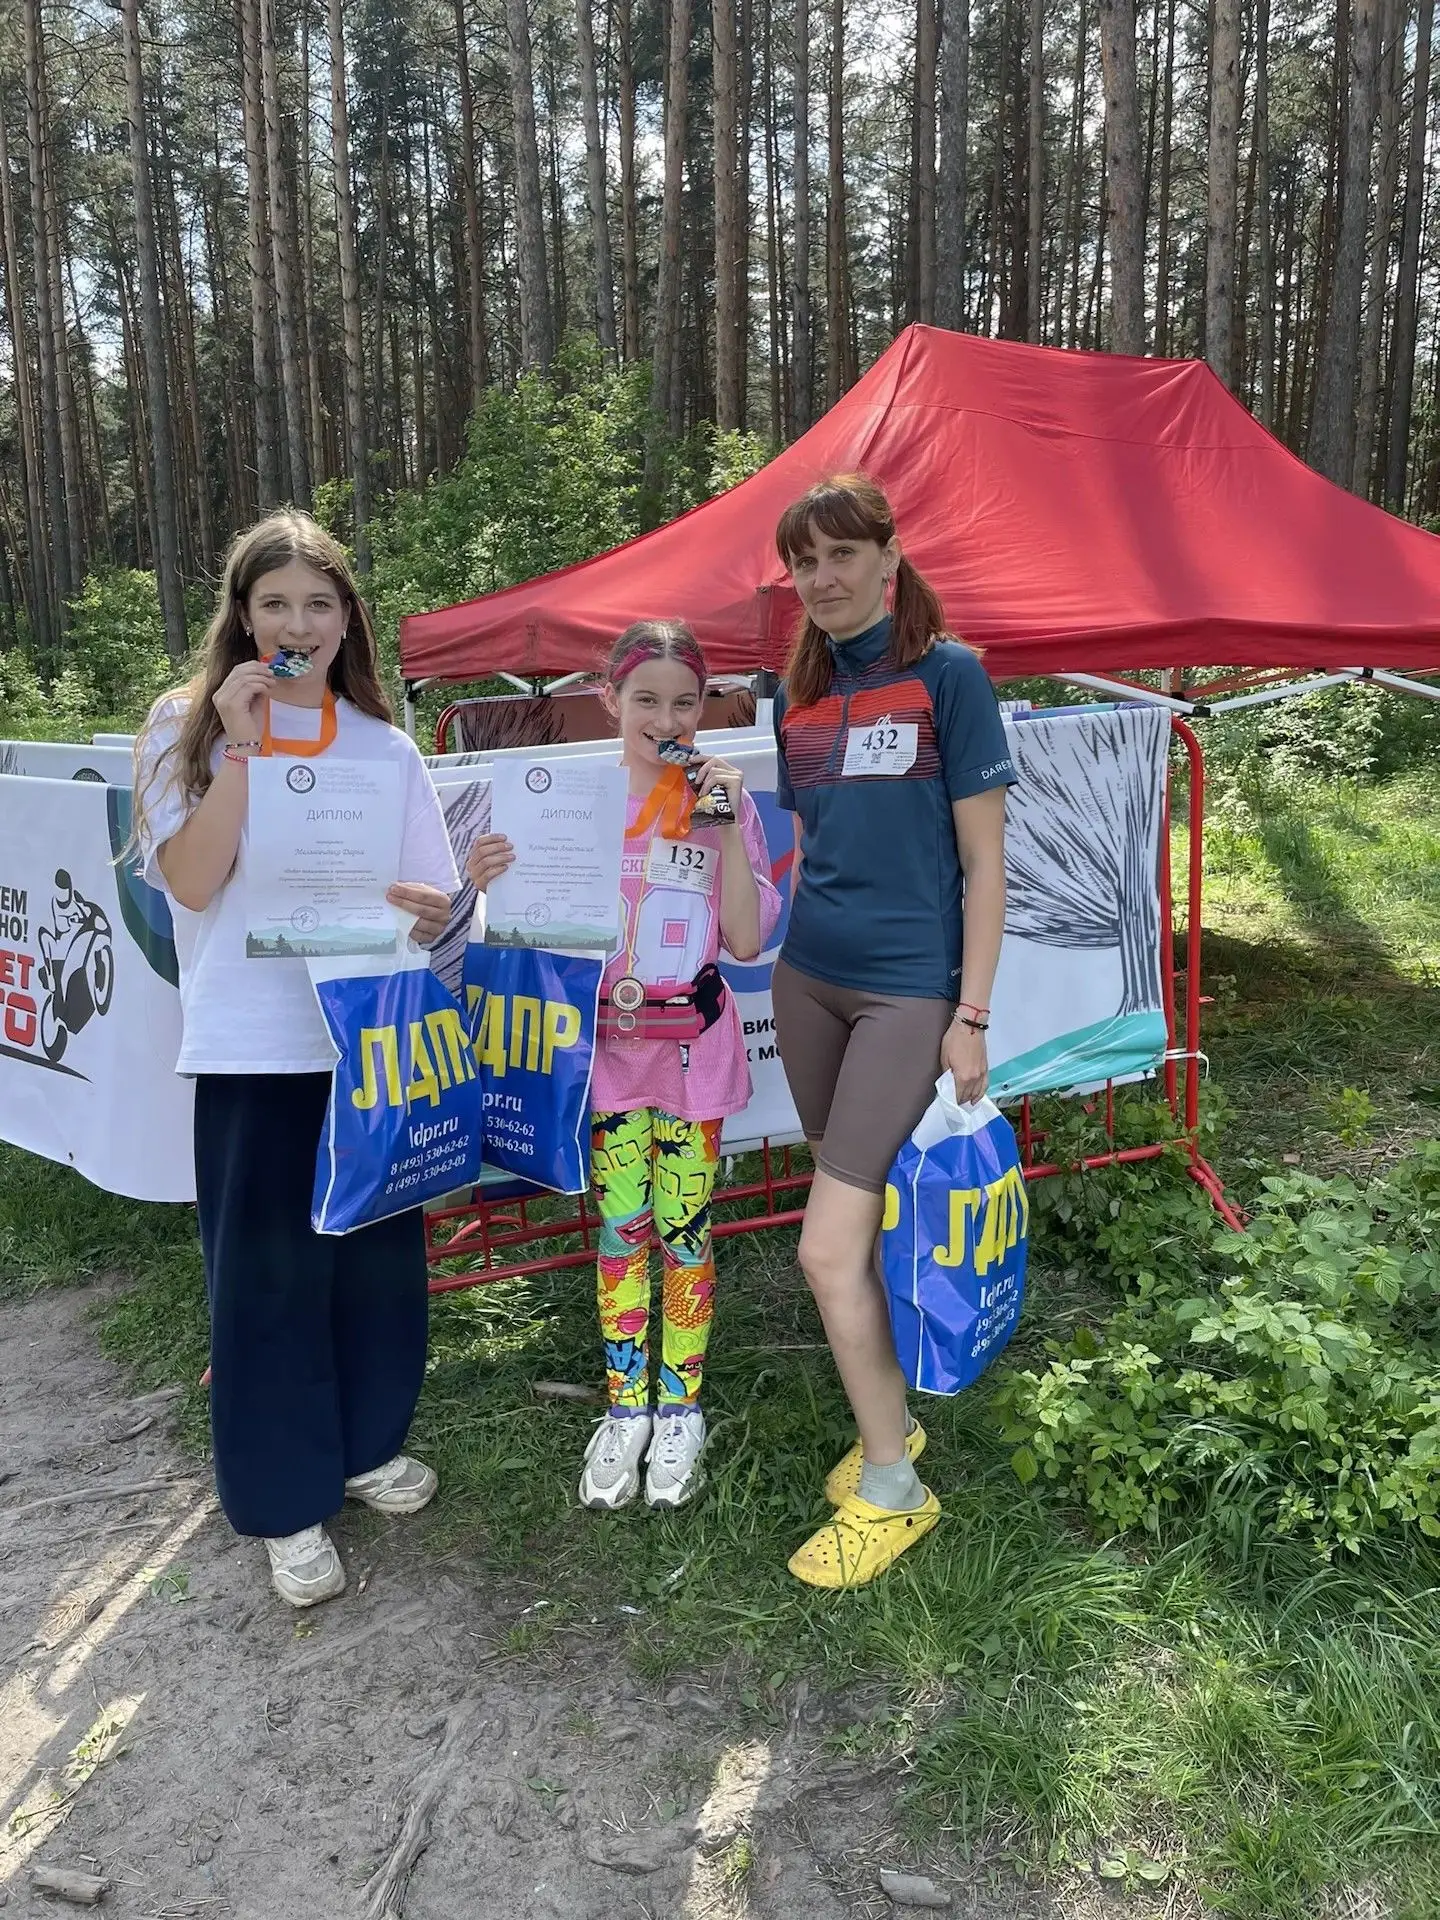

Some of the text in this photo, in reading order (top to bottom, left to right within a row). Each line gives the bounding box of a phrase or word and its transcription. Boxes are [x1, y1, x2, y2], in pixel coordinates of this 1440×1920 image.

[861, 729, 899, 751] 432
[306, 808, 363, 822] ДИПЛОМ
[540, 807, 593, 821] ДИПЛОМ
[669, 845, 706, 870] 132
[408, 1116, 459, 1148] ldpr.ru
[486, 1115, 535, 1137] 530-62-62
[390, 1163, 398, 1176] 8
[424, 1134, 470, 1163] 530-62-62
[385, 1182, 394, 1195] 8
[421, 1153, 466, 1182] 530-62-03
